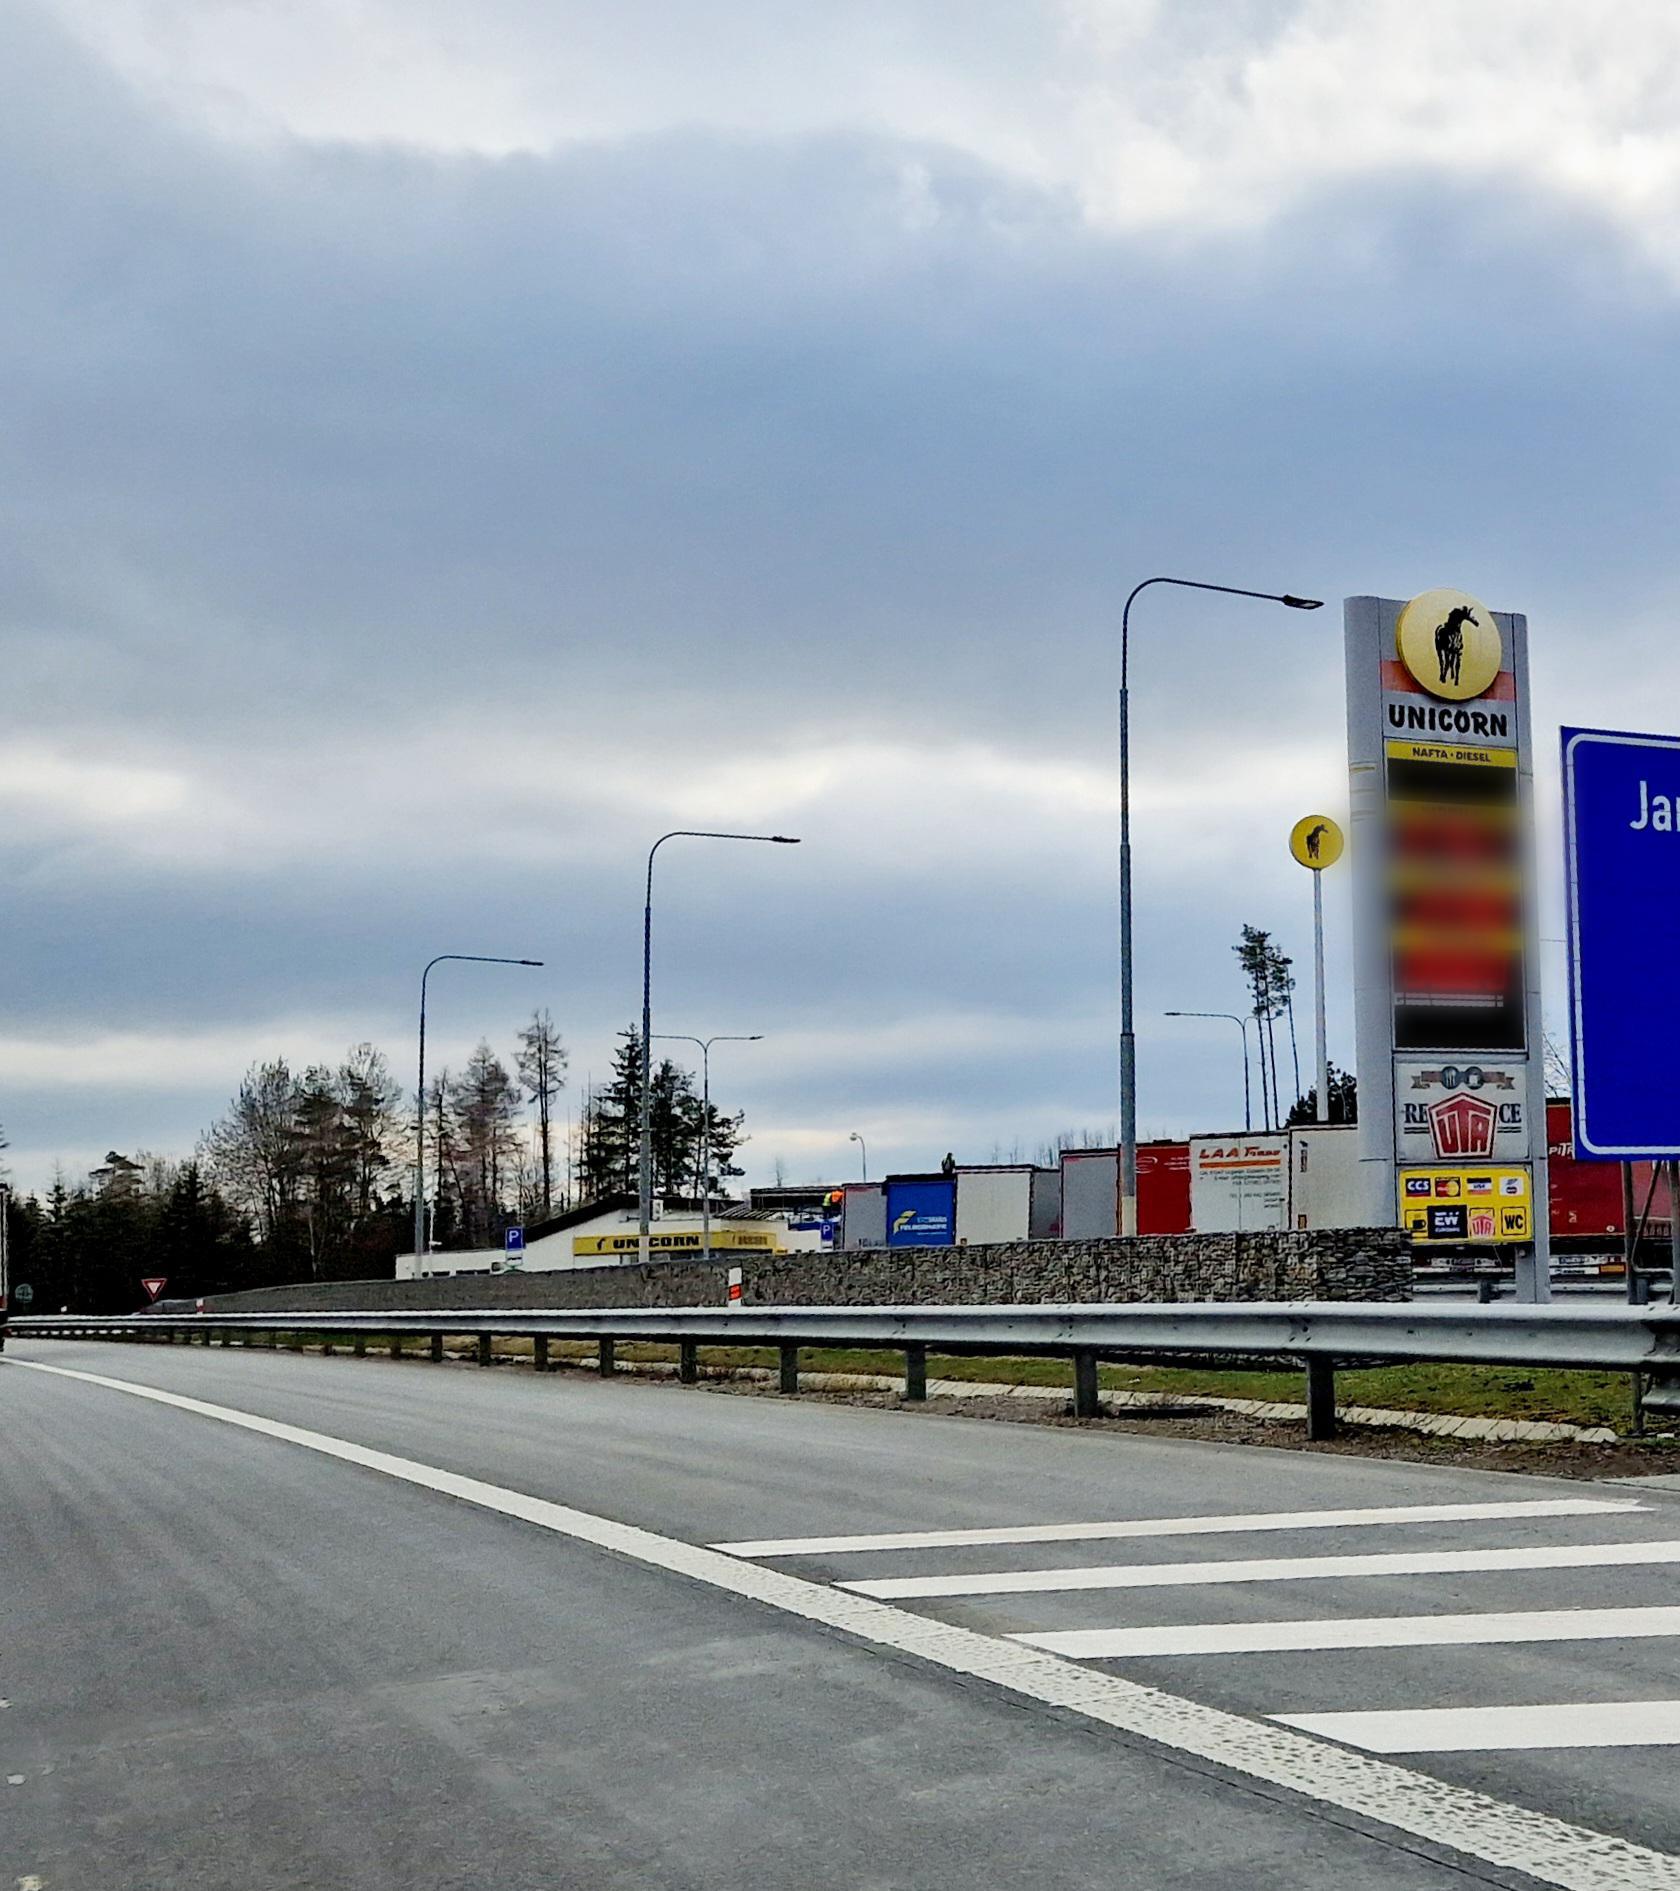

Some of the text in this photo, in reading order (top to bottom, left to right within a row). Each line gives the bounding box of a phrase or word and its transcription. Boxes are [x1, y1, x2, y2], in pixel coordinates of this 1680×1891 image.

[1388, 703, 1508, 738] UNICORN
[1412, 746, 1492, 763] NAFTA DIESEL
[1435, 1098, 1491, 1154] UTA
[1406, 1180, 1430, 1191] CCS
[1504, 1214, 1524, 1230] WC
[509, 1230, 519, 1243] P
[612, 1235, 700, 1250] UNCORN
